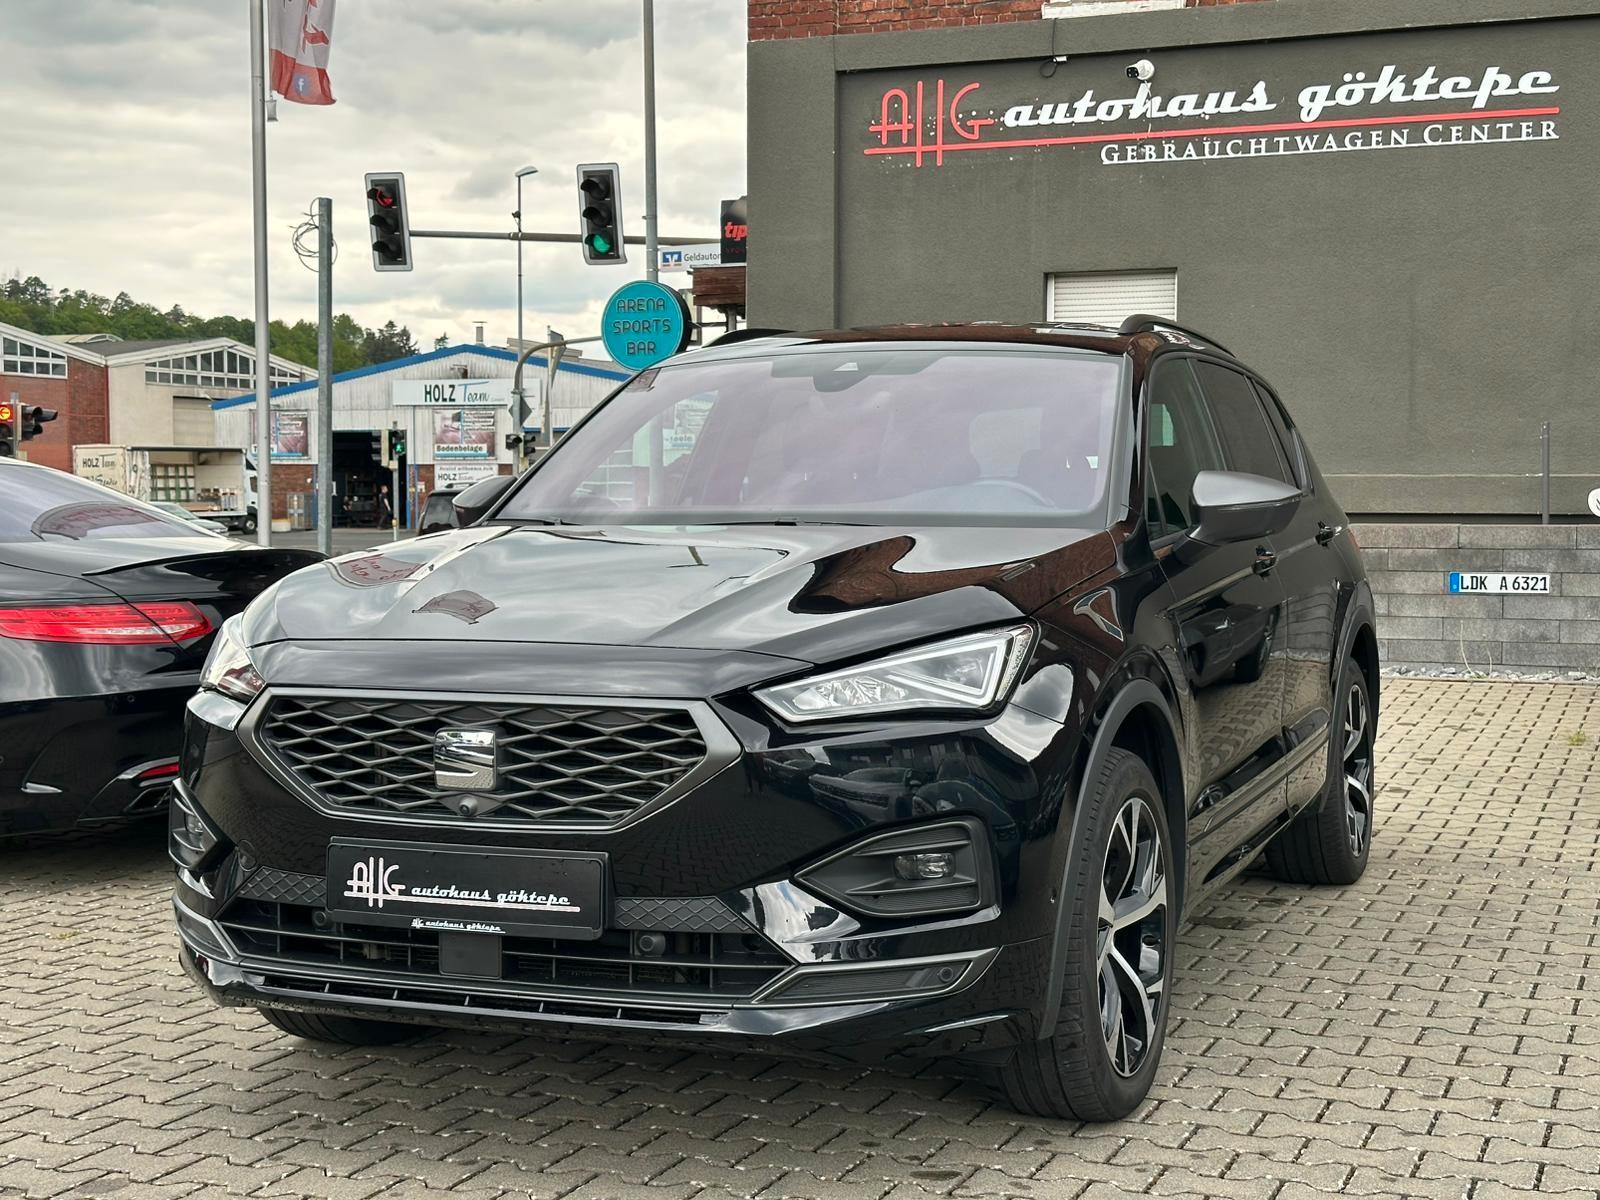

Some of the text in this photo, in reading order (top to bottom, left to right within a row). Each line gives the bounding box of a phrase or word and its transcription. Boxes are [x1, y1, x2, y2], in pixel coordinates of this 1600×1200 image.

[868, 64, 1560, 168] AHG autohaus göktepe
[617, 297, 666, 314] ARENA
[613, 319, 671, 334] SPORTS
[626, 341, 657, 355] BAR
[424, 381, 489, 403] HOLZ Team
[82, 457, 99, 468] HOLZ
[438, 473, 457, 481] HOLZ
[1460, 575, 1548, 591] LDK A 6321
[346, 856, 571, 908] AHG autohaus göktepe
[425, 920, 464, 928] autohaus
[466, 923, 501, 931] göktepe
